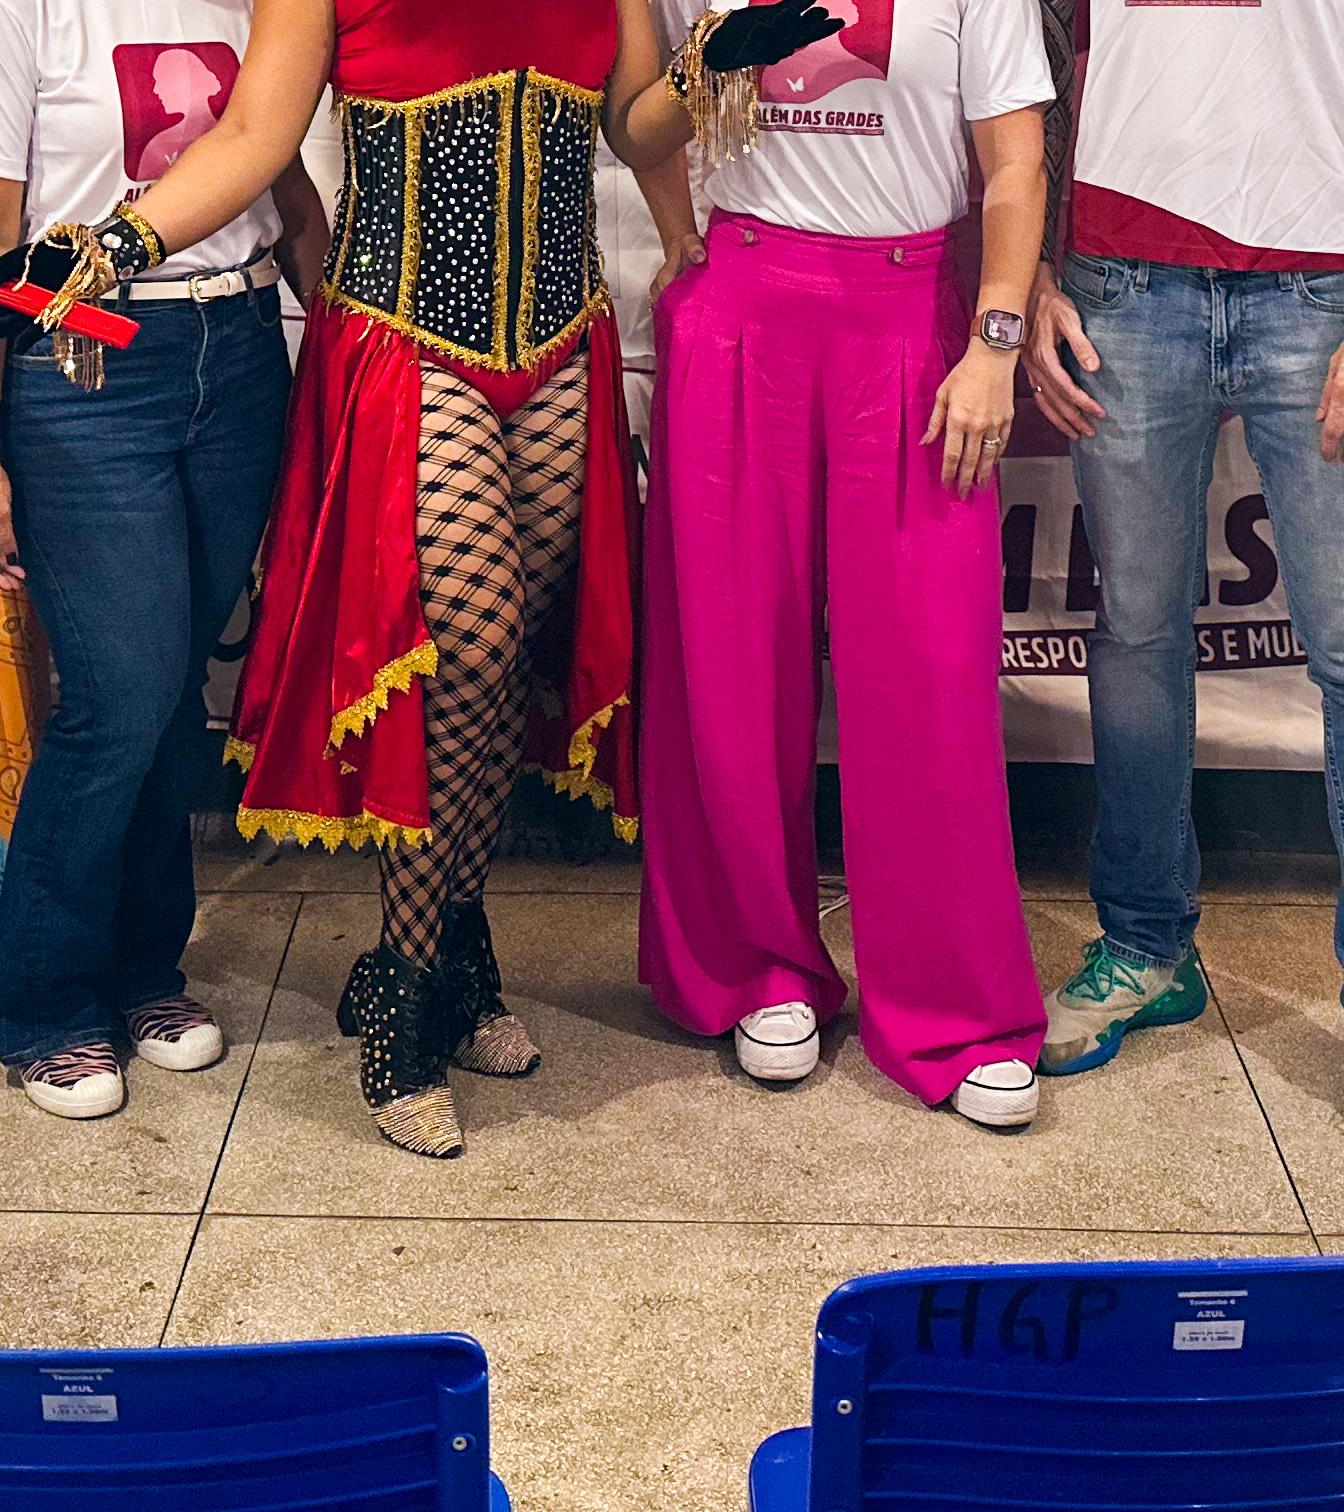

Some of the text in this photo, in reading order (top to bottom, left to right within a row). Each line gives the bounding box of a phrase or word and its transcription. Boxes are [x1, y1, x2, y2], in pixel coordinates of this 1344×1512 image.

[792, 110, 821, 125] DAS
[825, 111, 883, 127] GRADES
[1248, 627, 1306, 659] MUL
[918, 1281, 1120, 1361] HGP
